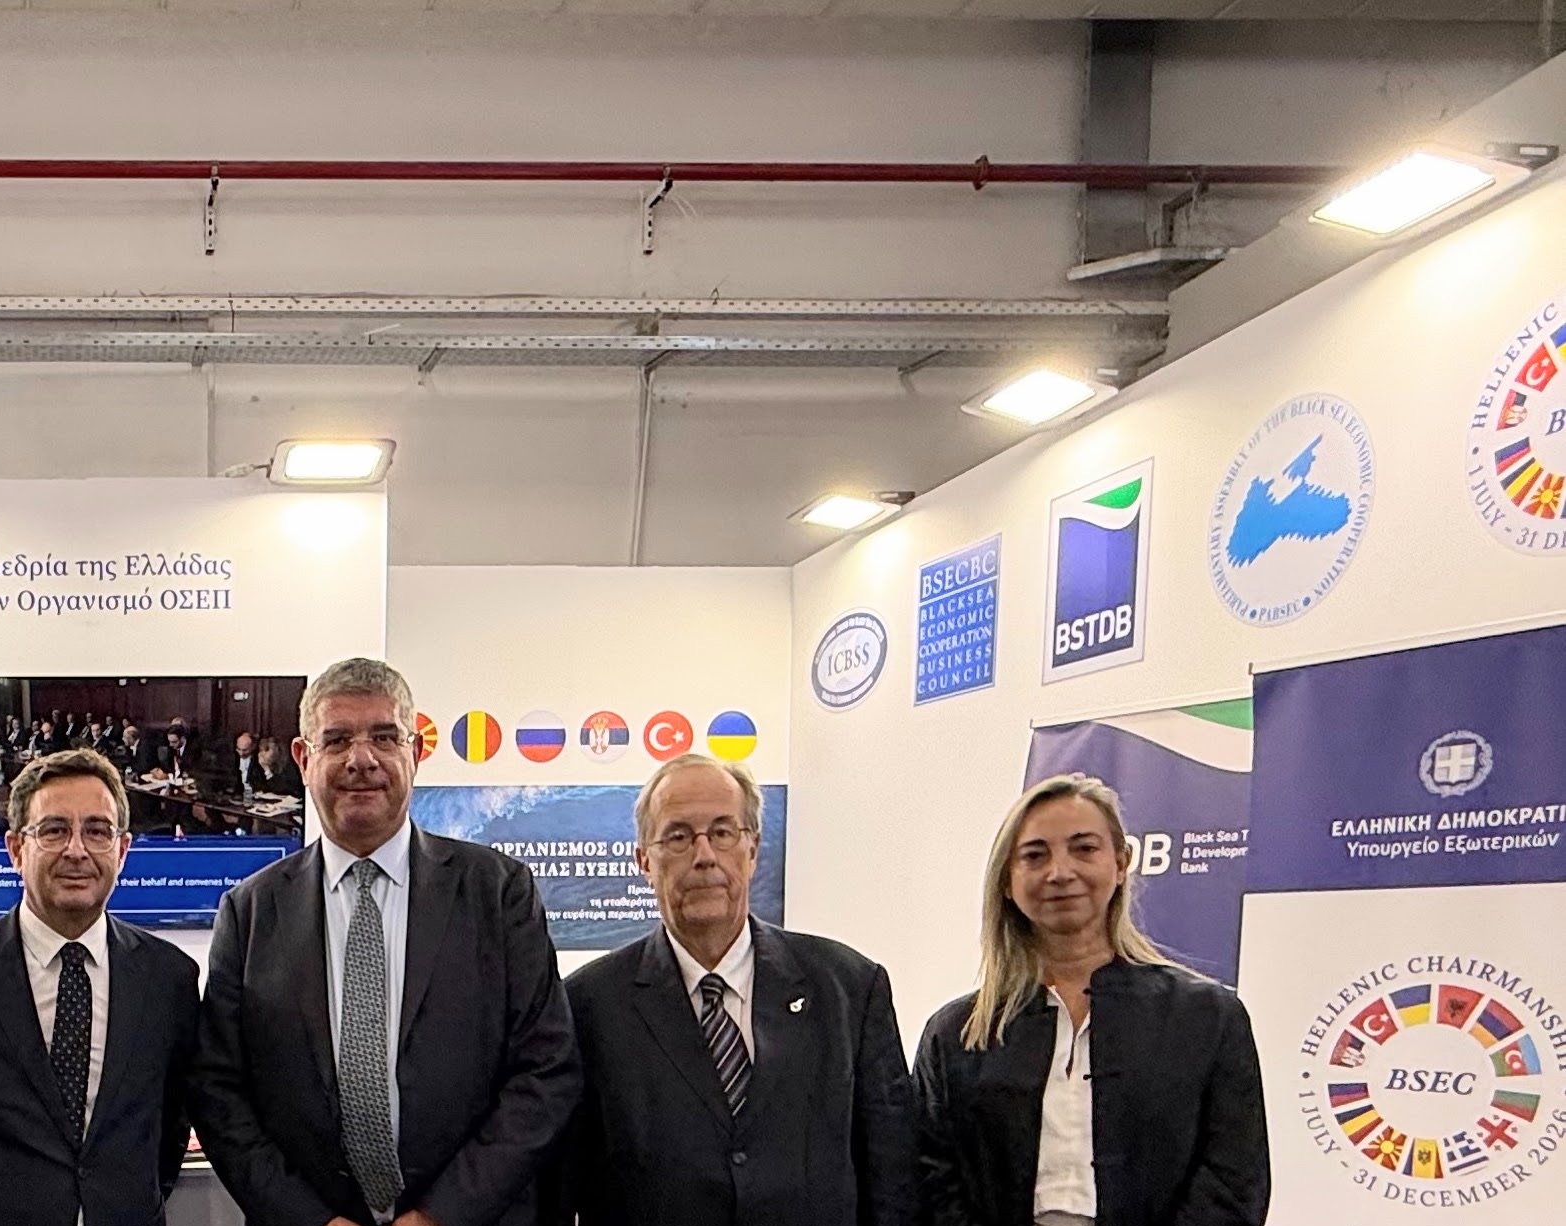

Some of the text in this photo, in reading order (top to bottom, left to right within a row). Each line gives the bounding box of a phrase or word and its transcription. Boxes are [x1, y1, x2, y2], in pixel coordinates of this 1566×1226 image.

[1471, 302, 1559, 429] HELLENIC
[1470, 480, 1506, 528] JULY
[1516, 527, 1538, 548] 31
[75, 558, 116, 581] της
[124, 552, 232, 580] Ελλάδας
[921, 550, 996, 599] BSECBC
[17, 586, 152, 615] Οργανισμό
[160, 589, 232, 610] ΟΣΕΠ
[919, 604, 994, 641] ECONOMIC
[1055, 604, 1132, 655] BSTDB
[919, 624, 992, 659] COOPERATION
[828, 642, 870, 676] ICBSS
[918, 642, 992, 677] BUSINESS
[917, 662, 991, 694] COUNCIL
[1183, 832, 1214, 844] Black
[1216, 830, 1239, 843] Sea
[1332, 804, 1566, 838] ΕΛΛΗΝΙΚΗ ΔΗΜΟΚΡΑΤΙ
[1346, 828, 1560, 860] Υπουργείο Εξωτερικών
[140, 877, 168, 887] behalf
[168, 877, 184, 887] and
[185, 879, 223, 887] convenes
[531, 862, 641, 877] ΣΙΑΣ ΕΥΞΕΙΝ
[1180, 862, 1209, 874] Bank
[603, 896, 658, 908] σταθερότητ
[1300, 963, 1398, 1057] HELLENIC
[1298, 1090, 1315, 1100] 1
[1384, 1069, 1477, 1096] BSEC
[1301, 1106, 1342, 1155] JULY
[1353, 1168, 1377, 1191] 31
[1383, 1162, 1533, 1208] DECEMBER
